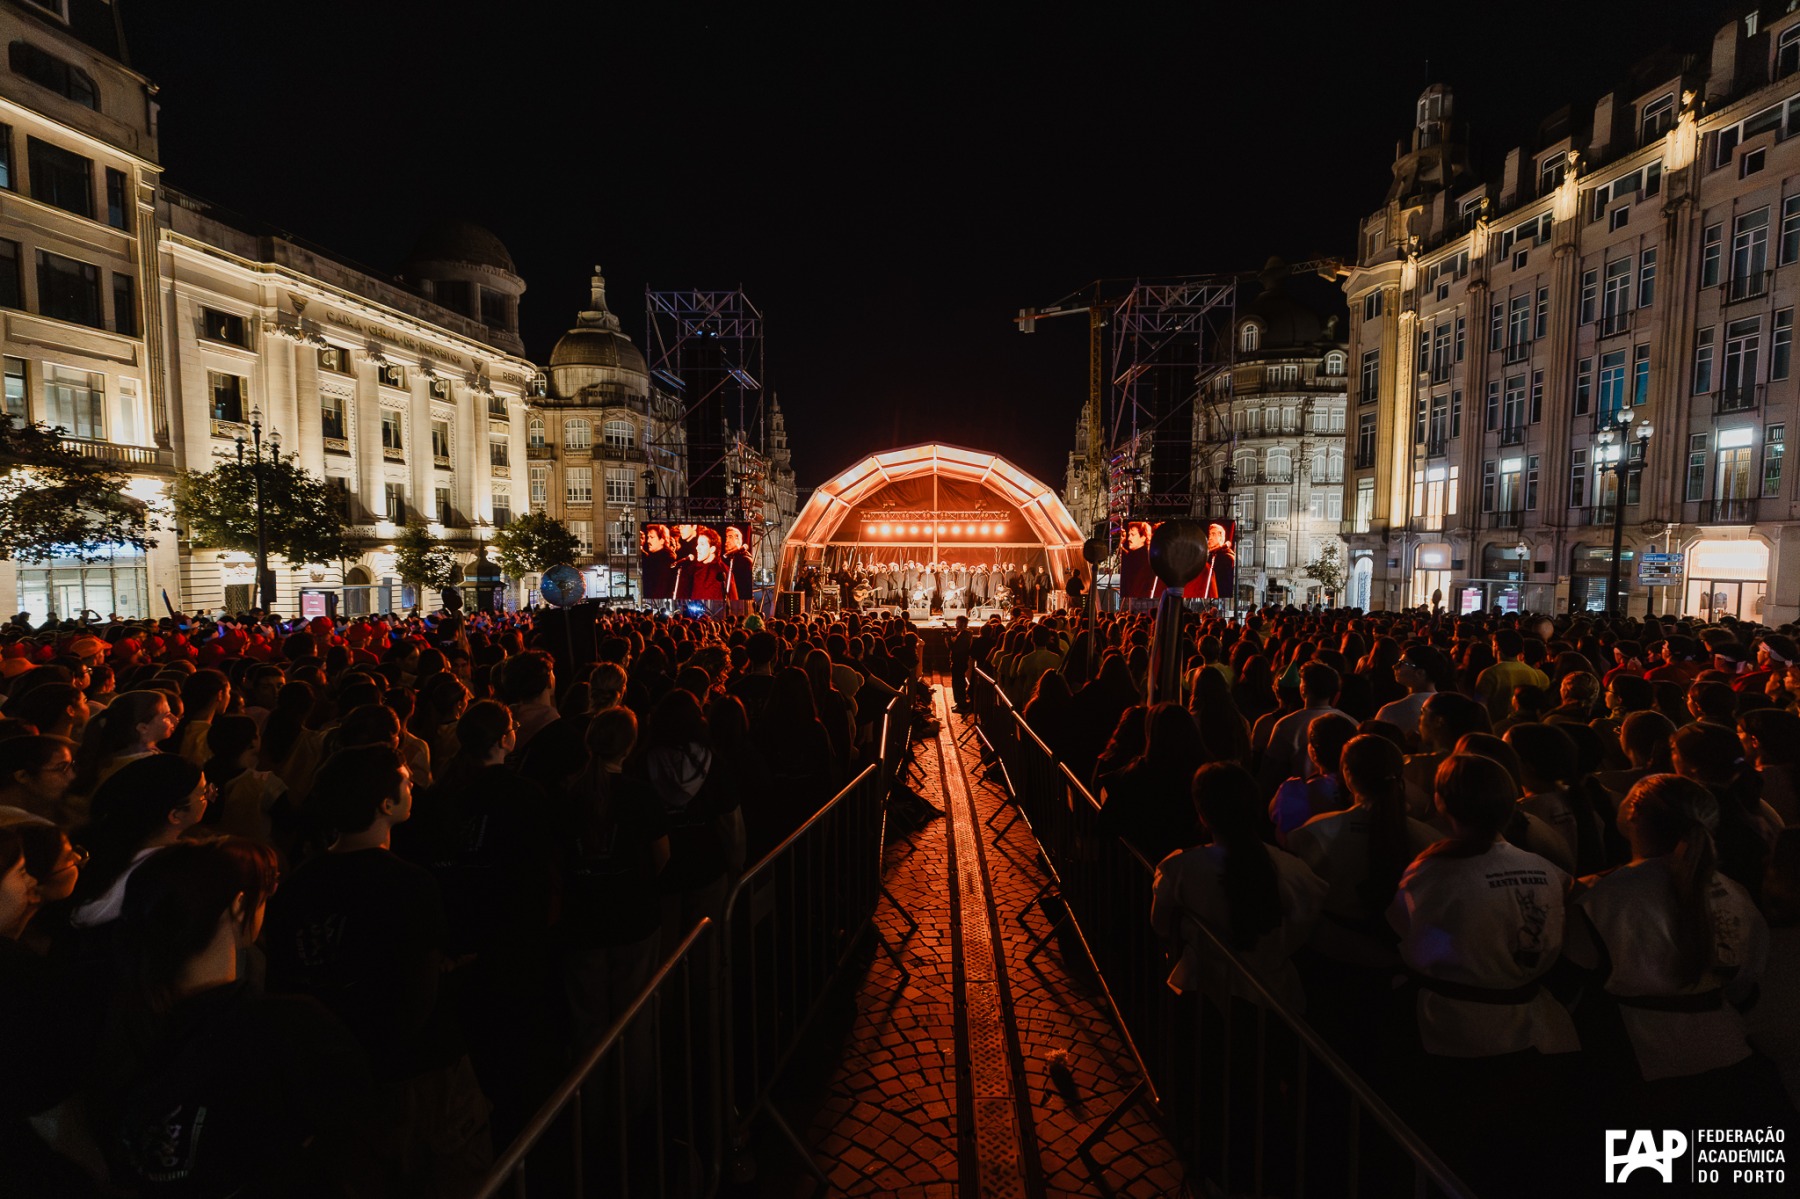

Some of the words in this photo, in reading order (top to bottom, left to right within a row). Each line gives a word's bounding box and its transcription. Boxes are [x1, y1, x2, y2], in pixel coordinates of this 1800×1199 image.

[326, 310, 362, 331] CAIXA
[368, 325, 399, 343] GERAL
[403, 336, 415, 349] DE
